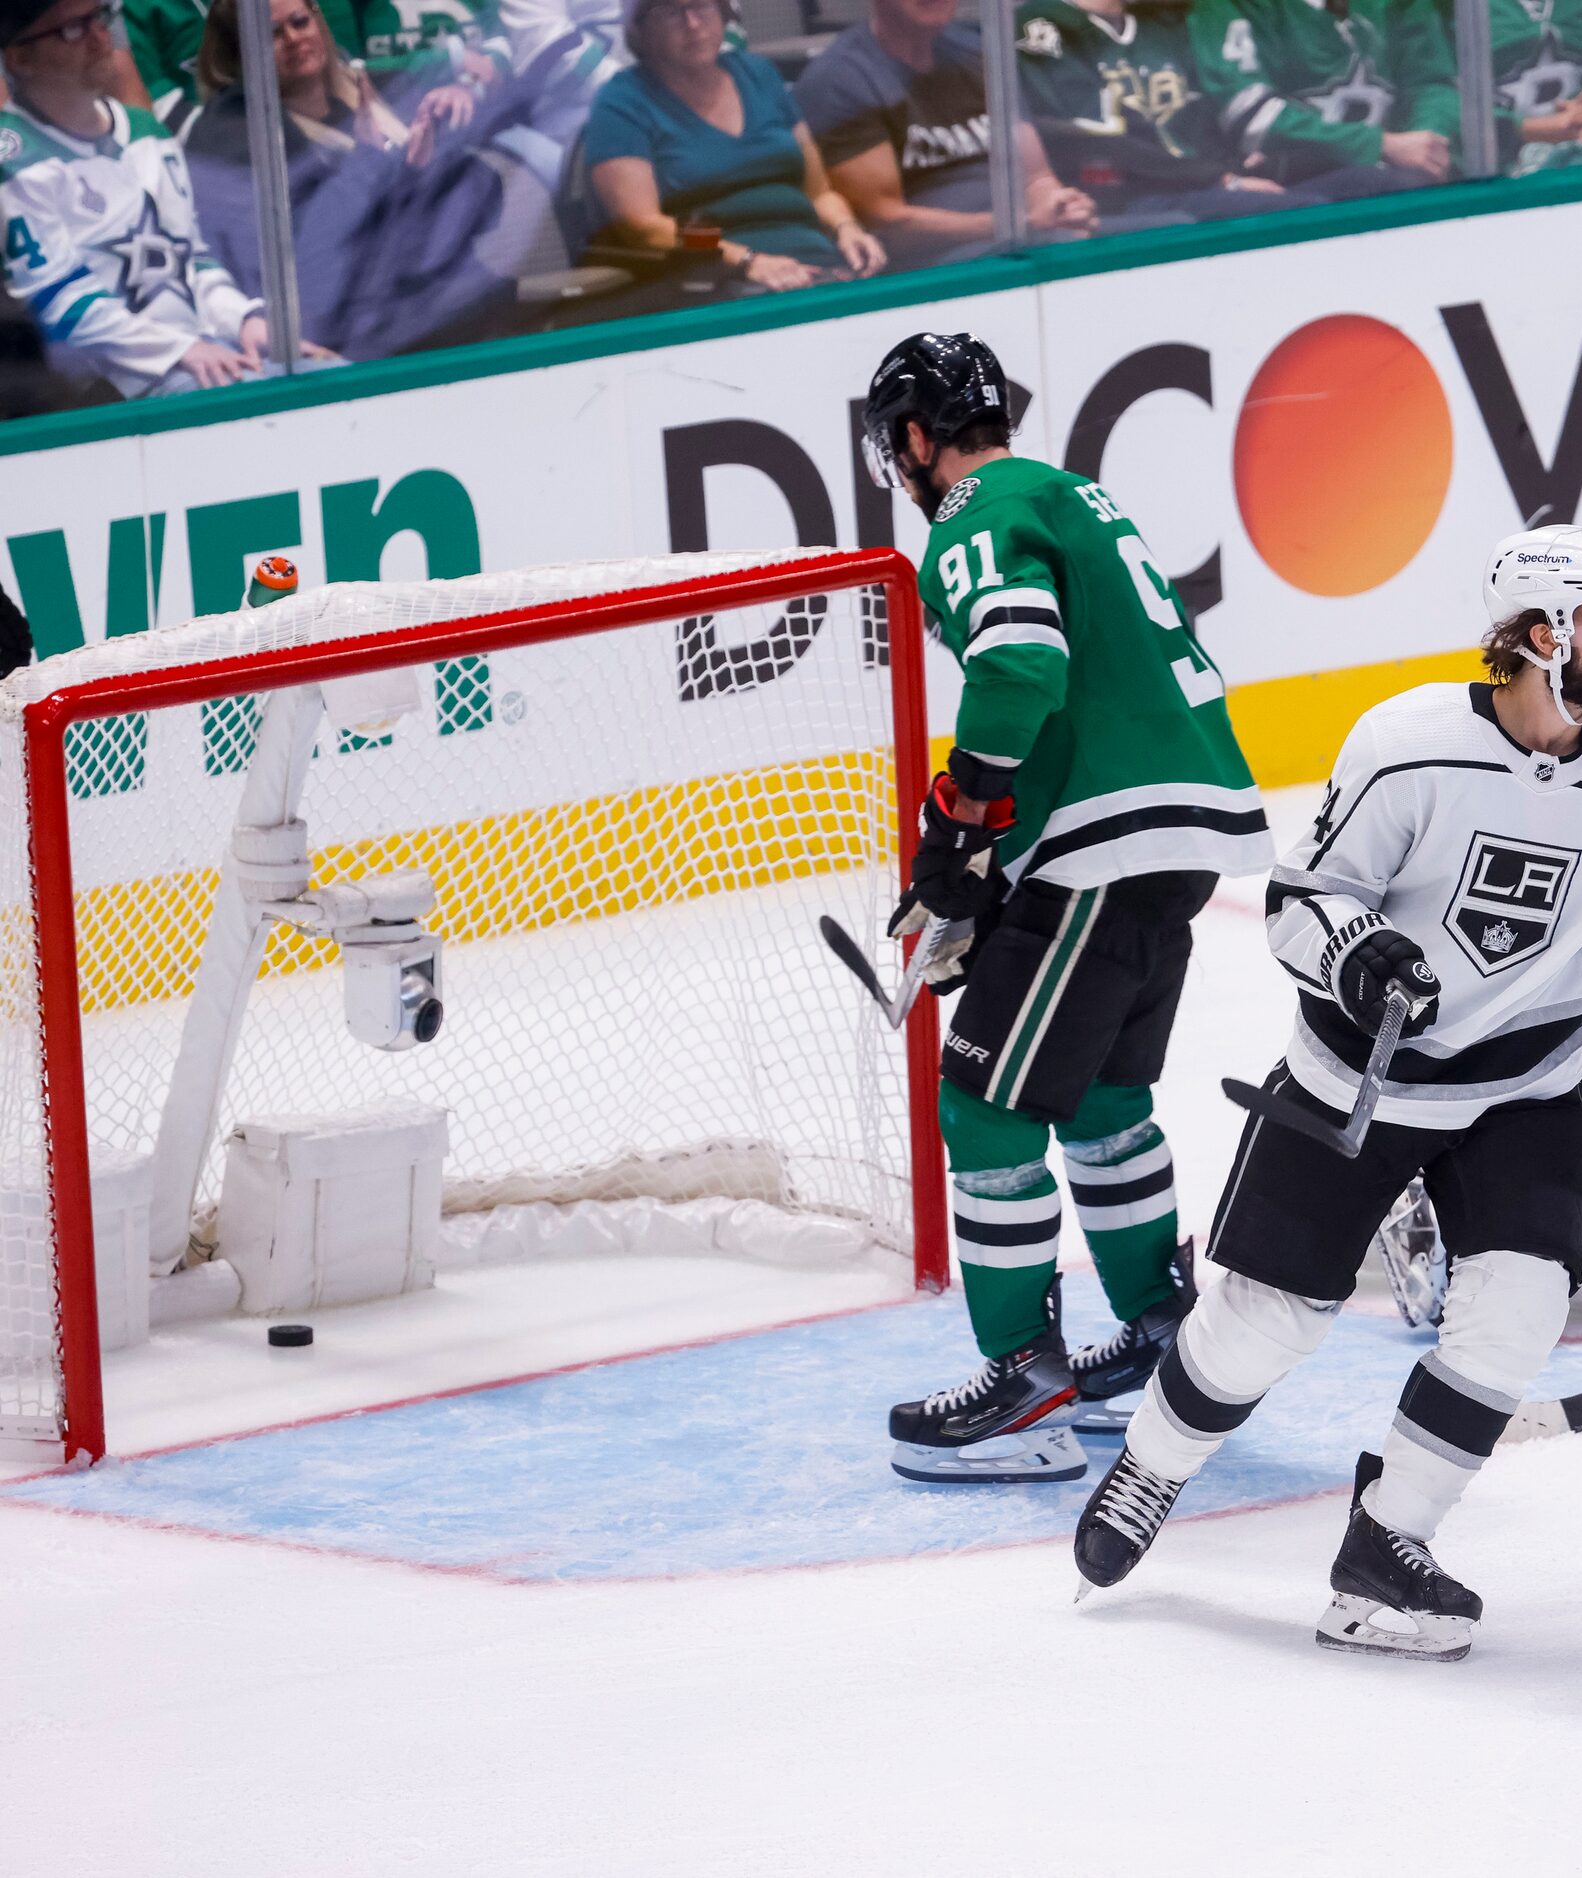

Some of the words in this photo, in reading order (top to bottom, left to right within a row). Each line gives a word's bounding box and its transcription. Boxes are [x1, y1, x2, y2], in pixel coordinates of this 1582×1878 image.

[6, 215, 48, 270] 4
[981, 384, 1001, 407] 91
[937, 529, 1005, 614] 91
[1516, 552, 1570, 565] Spectrum
[1471, 852, 1565, 903] LA
[1320, 912, 1387, 998] ARRIOR
